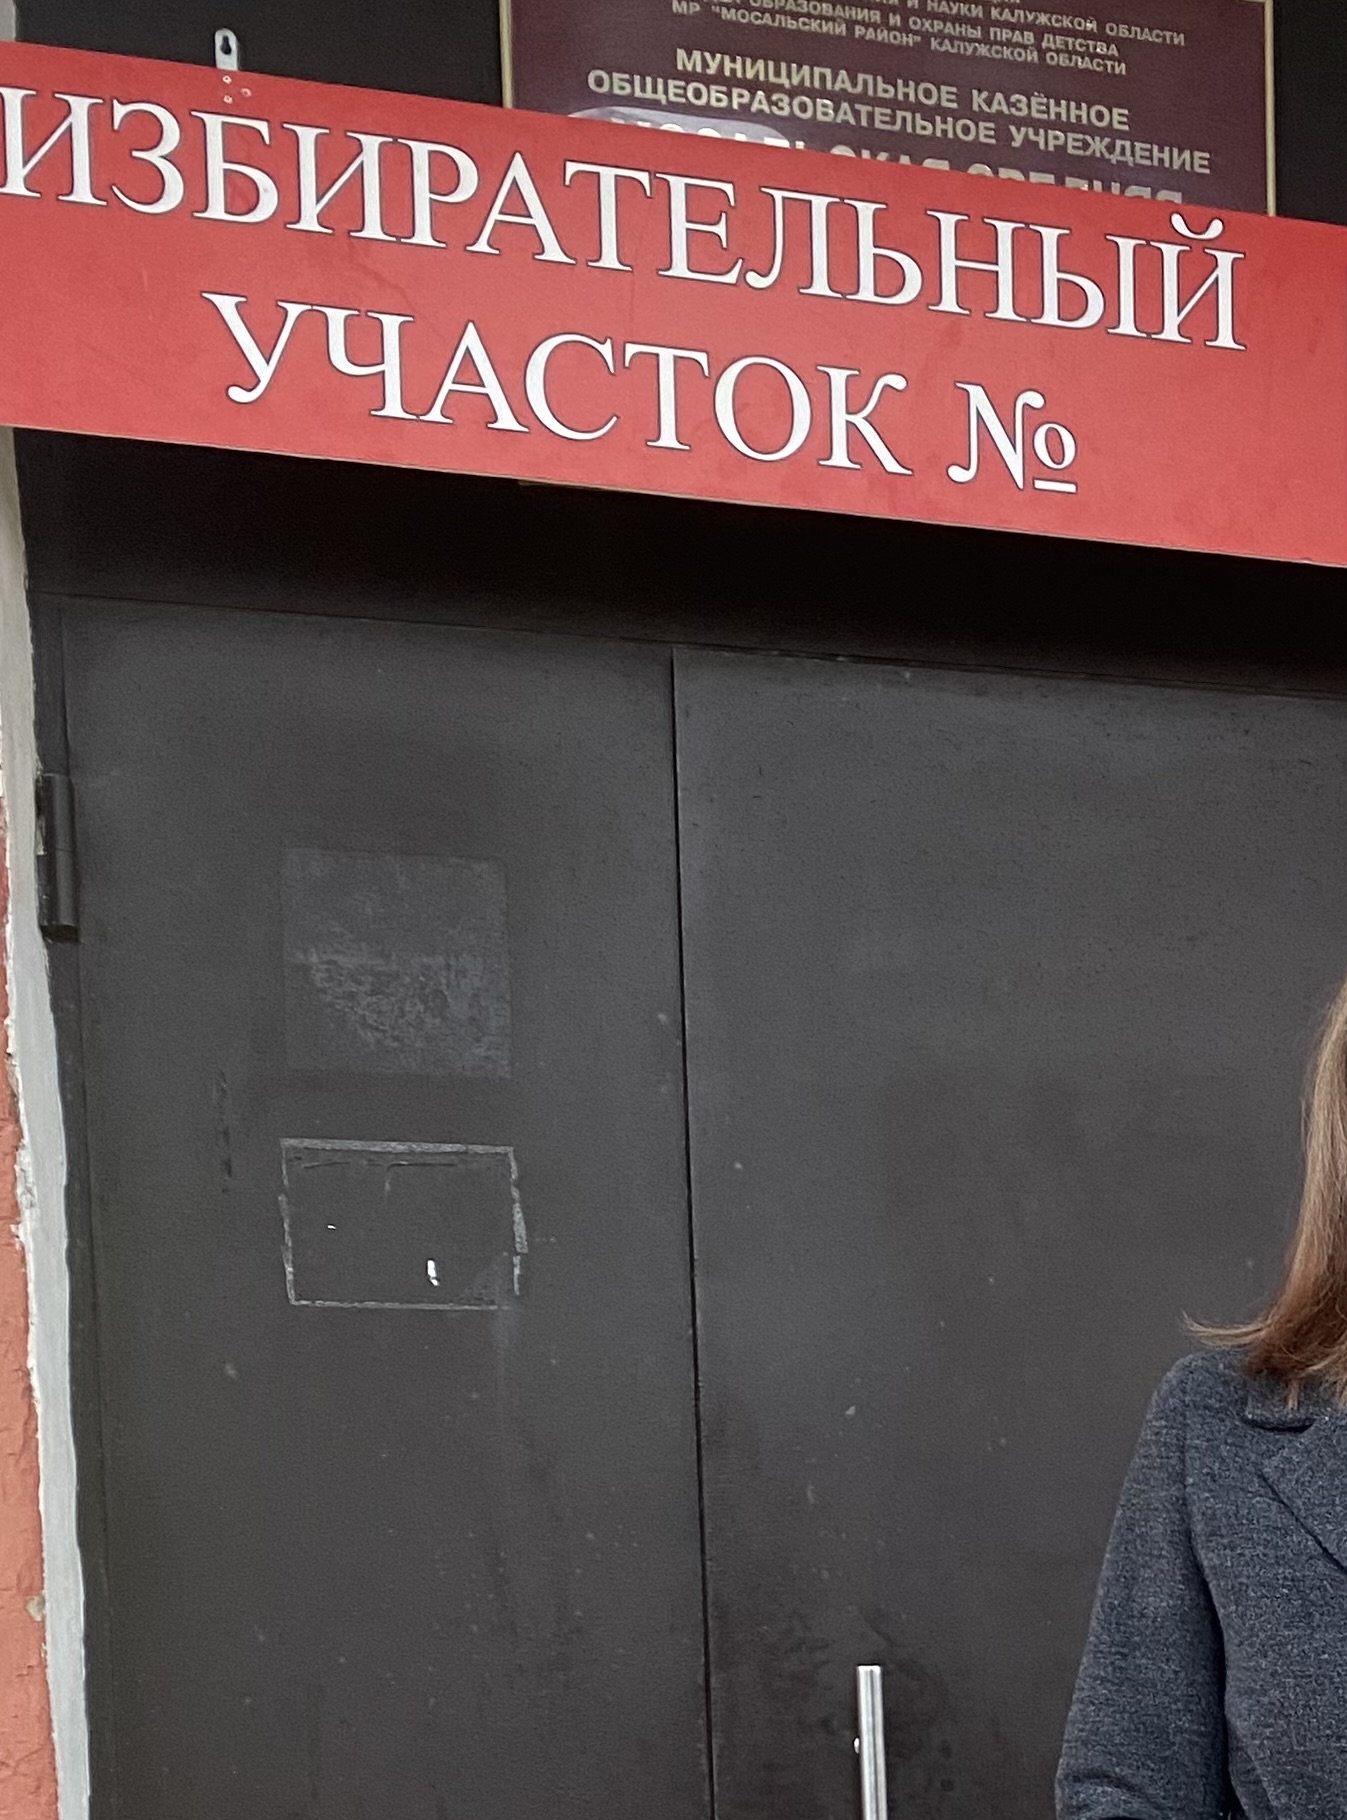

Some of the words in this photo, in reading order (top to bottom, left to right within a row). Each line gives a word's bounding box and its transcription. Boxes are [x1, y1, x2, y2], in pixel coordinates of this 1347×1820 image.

[889, 13, 902, 28] И
[908, 16, 982, 39] ОХРАНЫ
[989, 26, 1036, 46] ПРАВ
[1042, 33, 1120, 58] ДЕТСТВА
[926, 0, 983, 19] НАУКИ
[990, 6, 1098, 33] КАЛУЖСКОЙ
[1105, 22, 1186, 47] ОБЛАСТИ
[930, 36, 1039, 64] КАЛУЖСКОЙ
[1045, 51, 1127, 76] ОБЛАСТИ
[587, 69, 997, 145] ОБЩЕОБРАЗОВАТЕЛЬНОЕ
[1009, 124, 1212, 174] УЧРЕЖДЕНИЕ
[676, 48, 959, 109] МУНИЦИПАЛЬНОЕ
[971, 91, 1130, 131] КАЗЁННОЕ
[0, 86, 1247, 350] ИЗБИРАТЕЛЬНЫЙ
[201, 291, 914, 477] УЧАСТОК
[946, 381, 1079, 495] №
